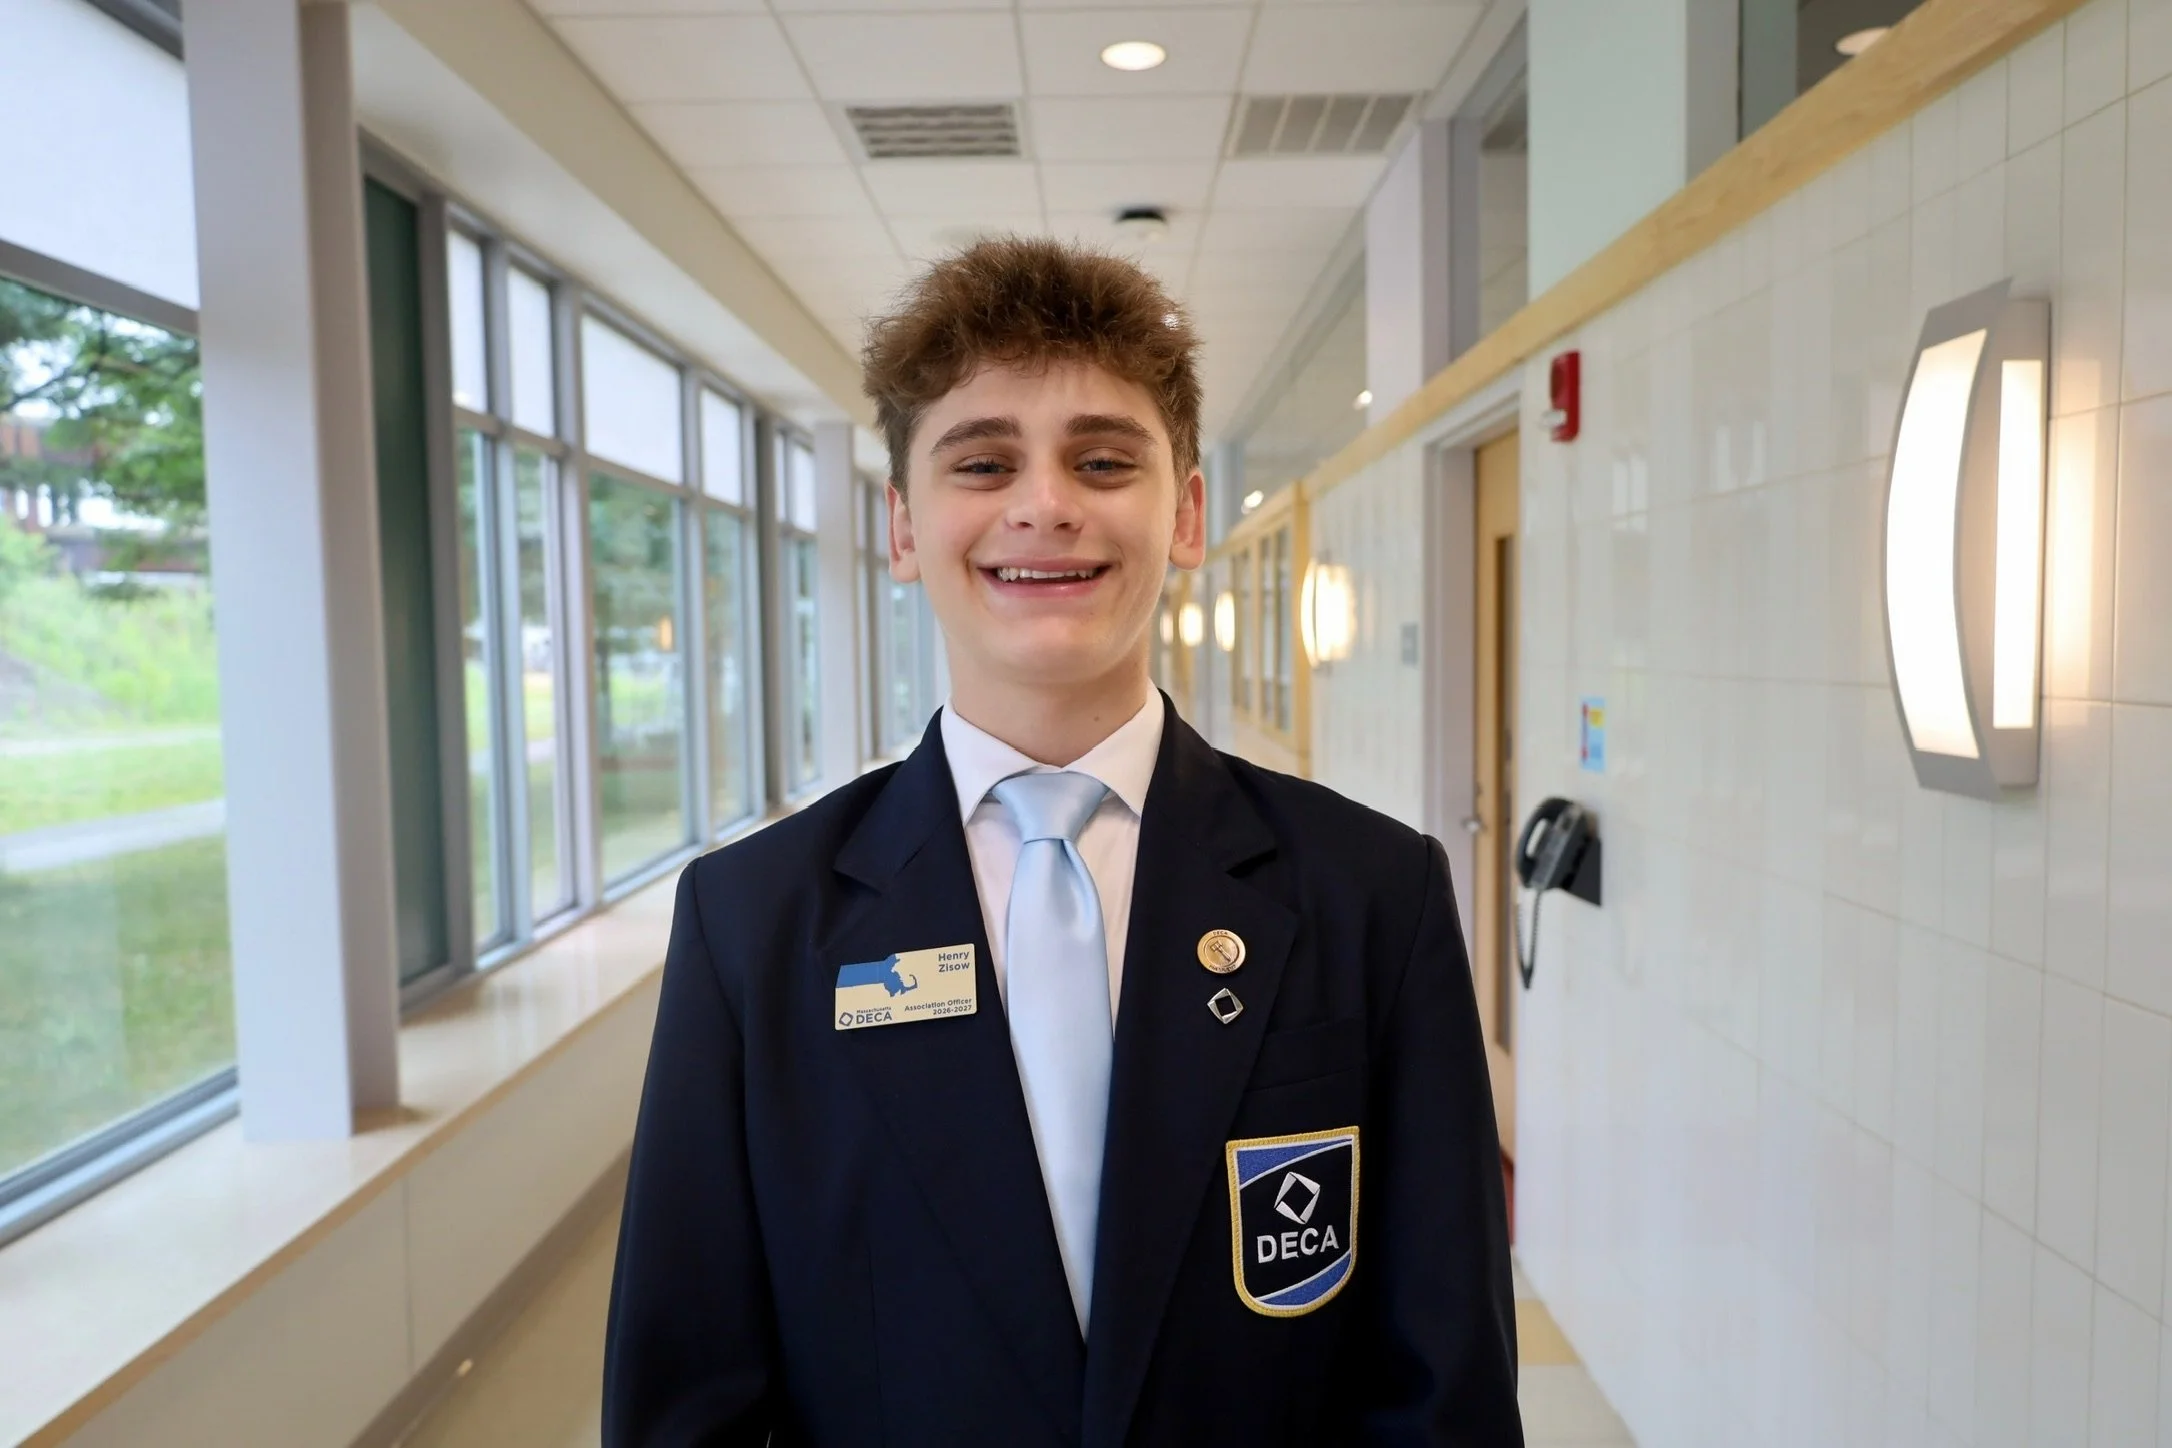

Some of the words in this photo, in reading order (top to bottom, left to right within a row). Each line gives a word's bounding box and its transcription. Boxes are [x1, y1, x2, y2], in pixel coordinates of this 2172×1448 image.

[938, 951, 970, 962] Henry
[938, 962, 970, 973] Zisow
[904, 1001, 946, 1012] Association
[947, 998, 972, 1007] Officer
[932, 1005, 972, 1016] 2026-2027
[856, 1011, 893, 1024] DECA
[1256, 1225, 1339, 1264] DECA
